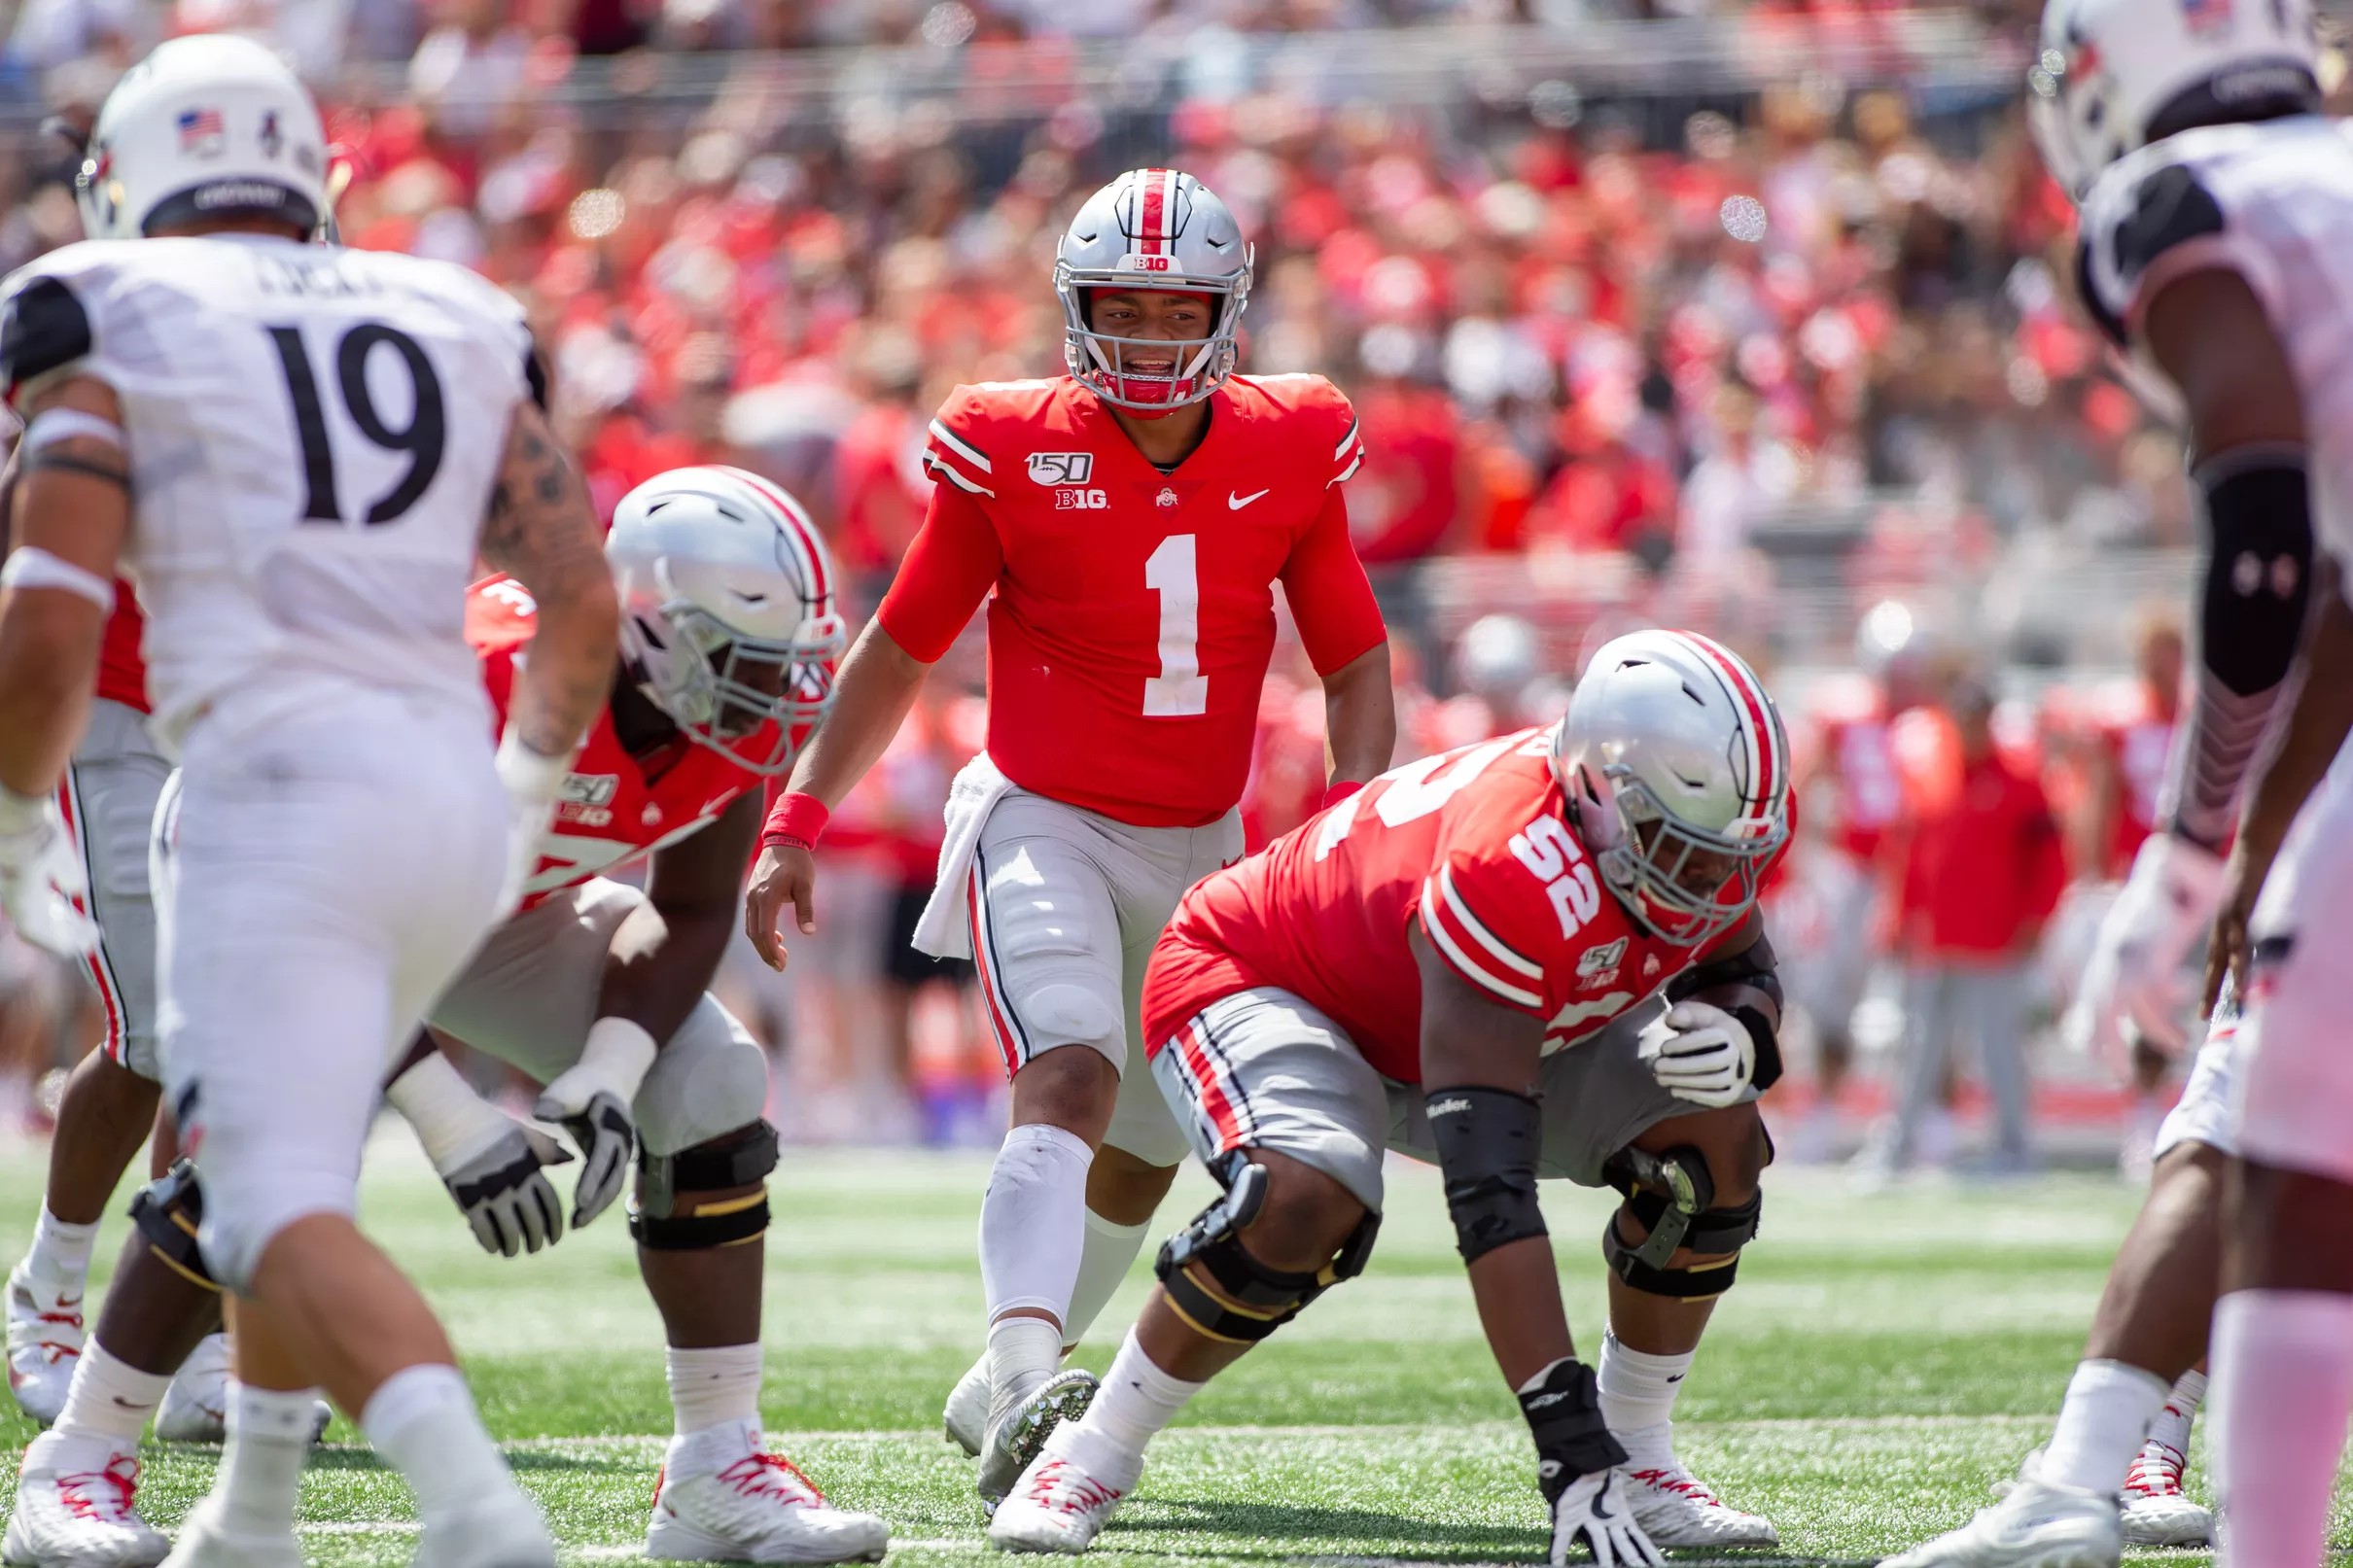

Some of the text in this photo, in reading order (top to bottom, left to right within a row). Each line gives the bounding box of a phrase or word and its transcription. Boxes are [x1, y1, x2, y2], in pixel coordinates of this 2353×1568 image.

[263, 323, 446, 526] 19
[1025, 453, 1094, 486] 150
[1142, 534, 1209, 715] 1
[1508, 814, 1600, 941] 52
